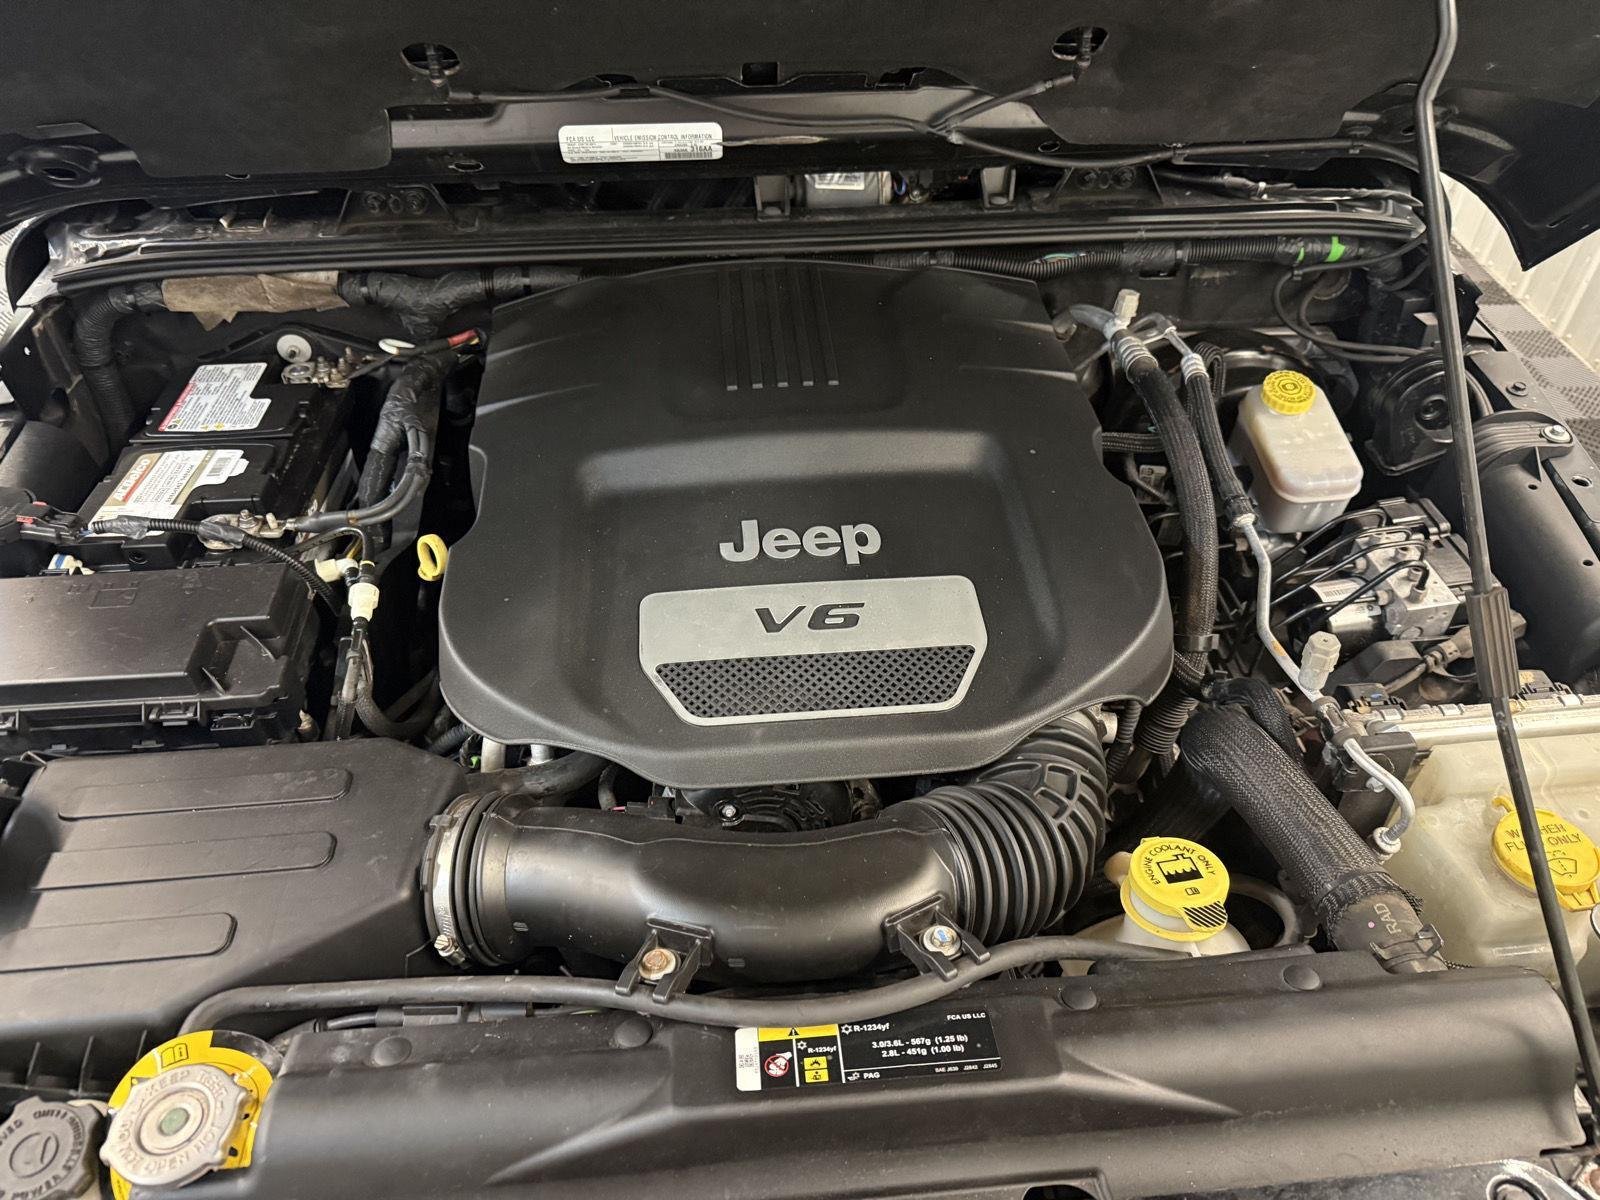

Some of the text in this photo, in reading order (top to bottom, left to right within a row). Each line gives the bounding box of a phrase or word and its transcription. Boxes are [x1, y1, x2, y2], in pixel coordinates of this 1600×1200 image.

[718, 519, 882, 565] Jeep
[755, 602, 865, 634] V6
[1547, 833, 1582, 846] ONLY
[1143, 845, 1216, 884] ENGINE COOLANT ONLY
[1374, 903, 1401, 934] RAD
[853, 1022, 890, 1032] R-1234yf
[807, 1045, 837, 1054] R-1234yf
[871, 1039, 904, 1049] 3.0/3.6L
[910, 1037, 931, 1046] 567g
[934, 1035, 956, 1045] (1.25
[956, 1034, 969, 1043] lb)
[881, 1049, 900, 1058] 2.8L
[906, 1047, 927, 1056] 451g
[930, 1045, 952, 1055] (1.00
[952, 1044, 965, 1053] lb)
[146, 1070, 190, 1096] KEEP
[144, 1151, 190, 1174] OPEN
